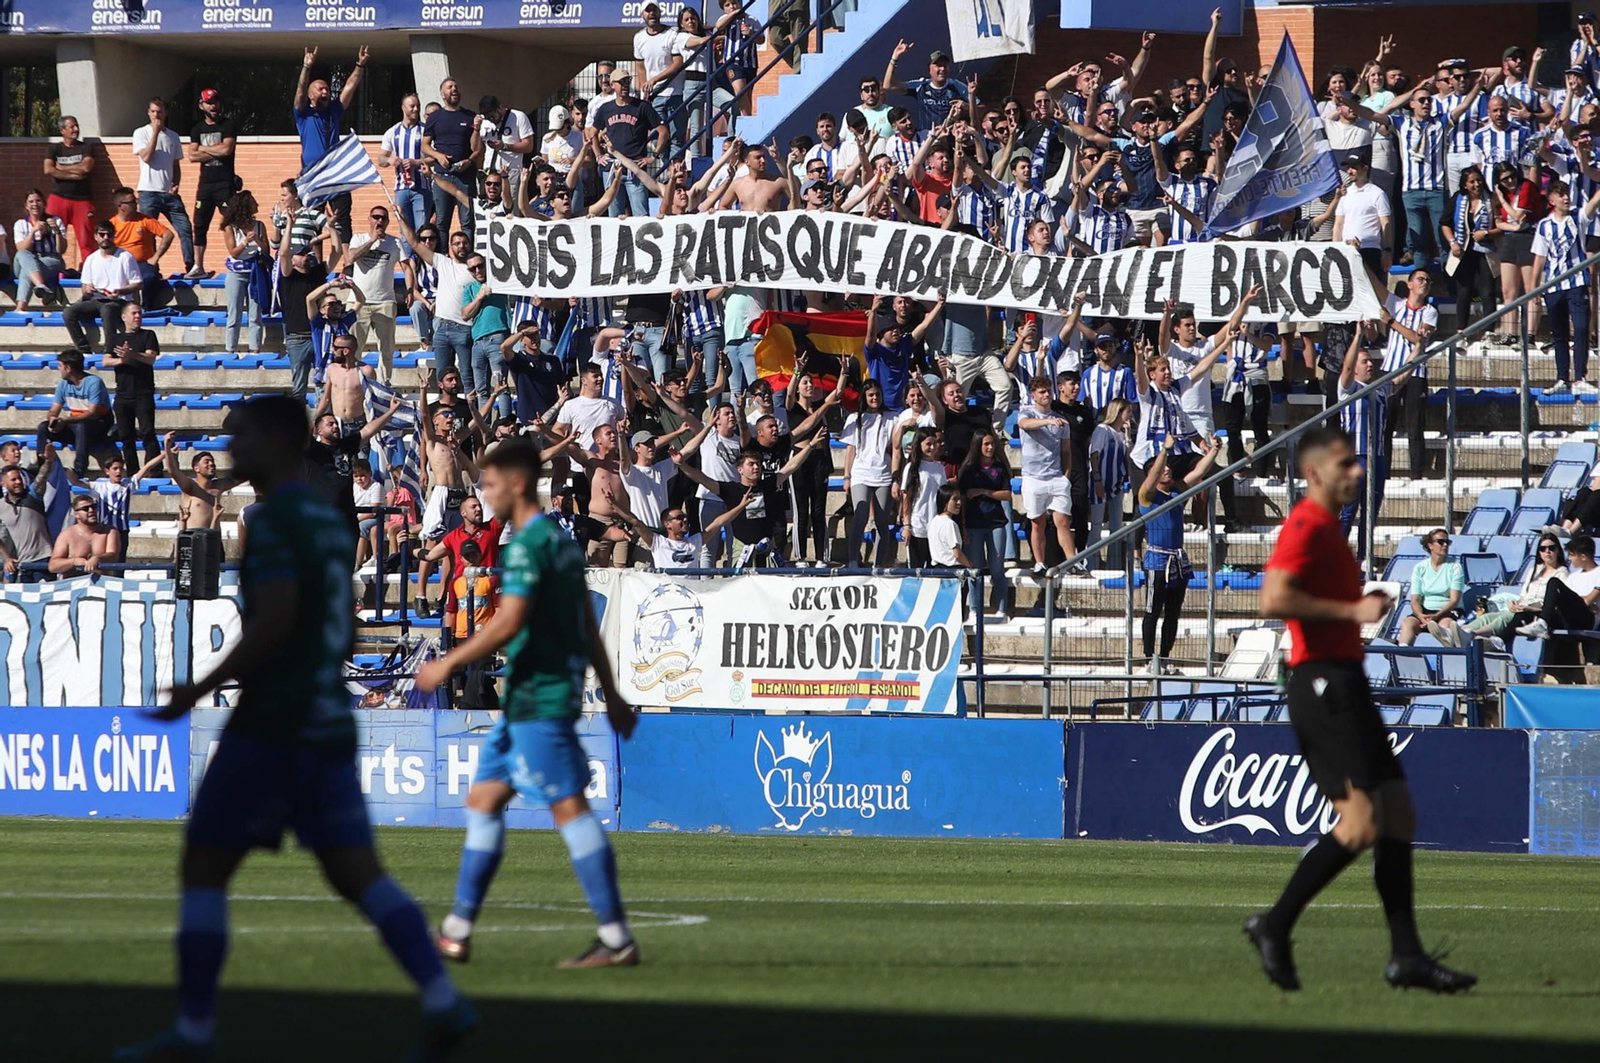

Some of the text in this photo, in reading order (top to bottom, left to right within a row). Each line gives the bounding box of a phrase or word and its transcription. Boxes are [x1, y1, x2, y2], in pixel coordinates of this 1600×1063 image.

[203, 8, 273, 22] enersun
[306, 7, 376, 21] enersun
[421, 5, 484, 20] enersun
[520, 3, 583, 18] enersun
[622, 1, 686, 17] ensun
[591, 222, 664, 286] LAS
[669, 215, 784, 285] RATAS
[787, 214, 877, 285] QUE
[876, 229, 1144, 315] ABANDONAN
[1144, 249, 1195, 313] EL
[1211, 244, 1354, 317] BARCO
[789, 584, 878, 611] SECTOR
[720, 615, 951, 672] HELICÓSTERO
[666, 678, 695, 696] Gol Sur
[758, 682, 801, 696] DECANO
[805, 683, 824, 696] DEL
[52, 734, 88, 791] LA
[93, 733, 175, 792] CINTA
[361, 743, 426, 795] rts
[764, 768, 911, 818] Chiguagua
